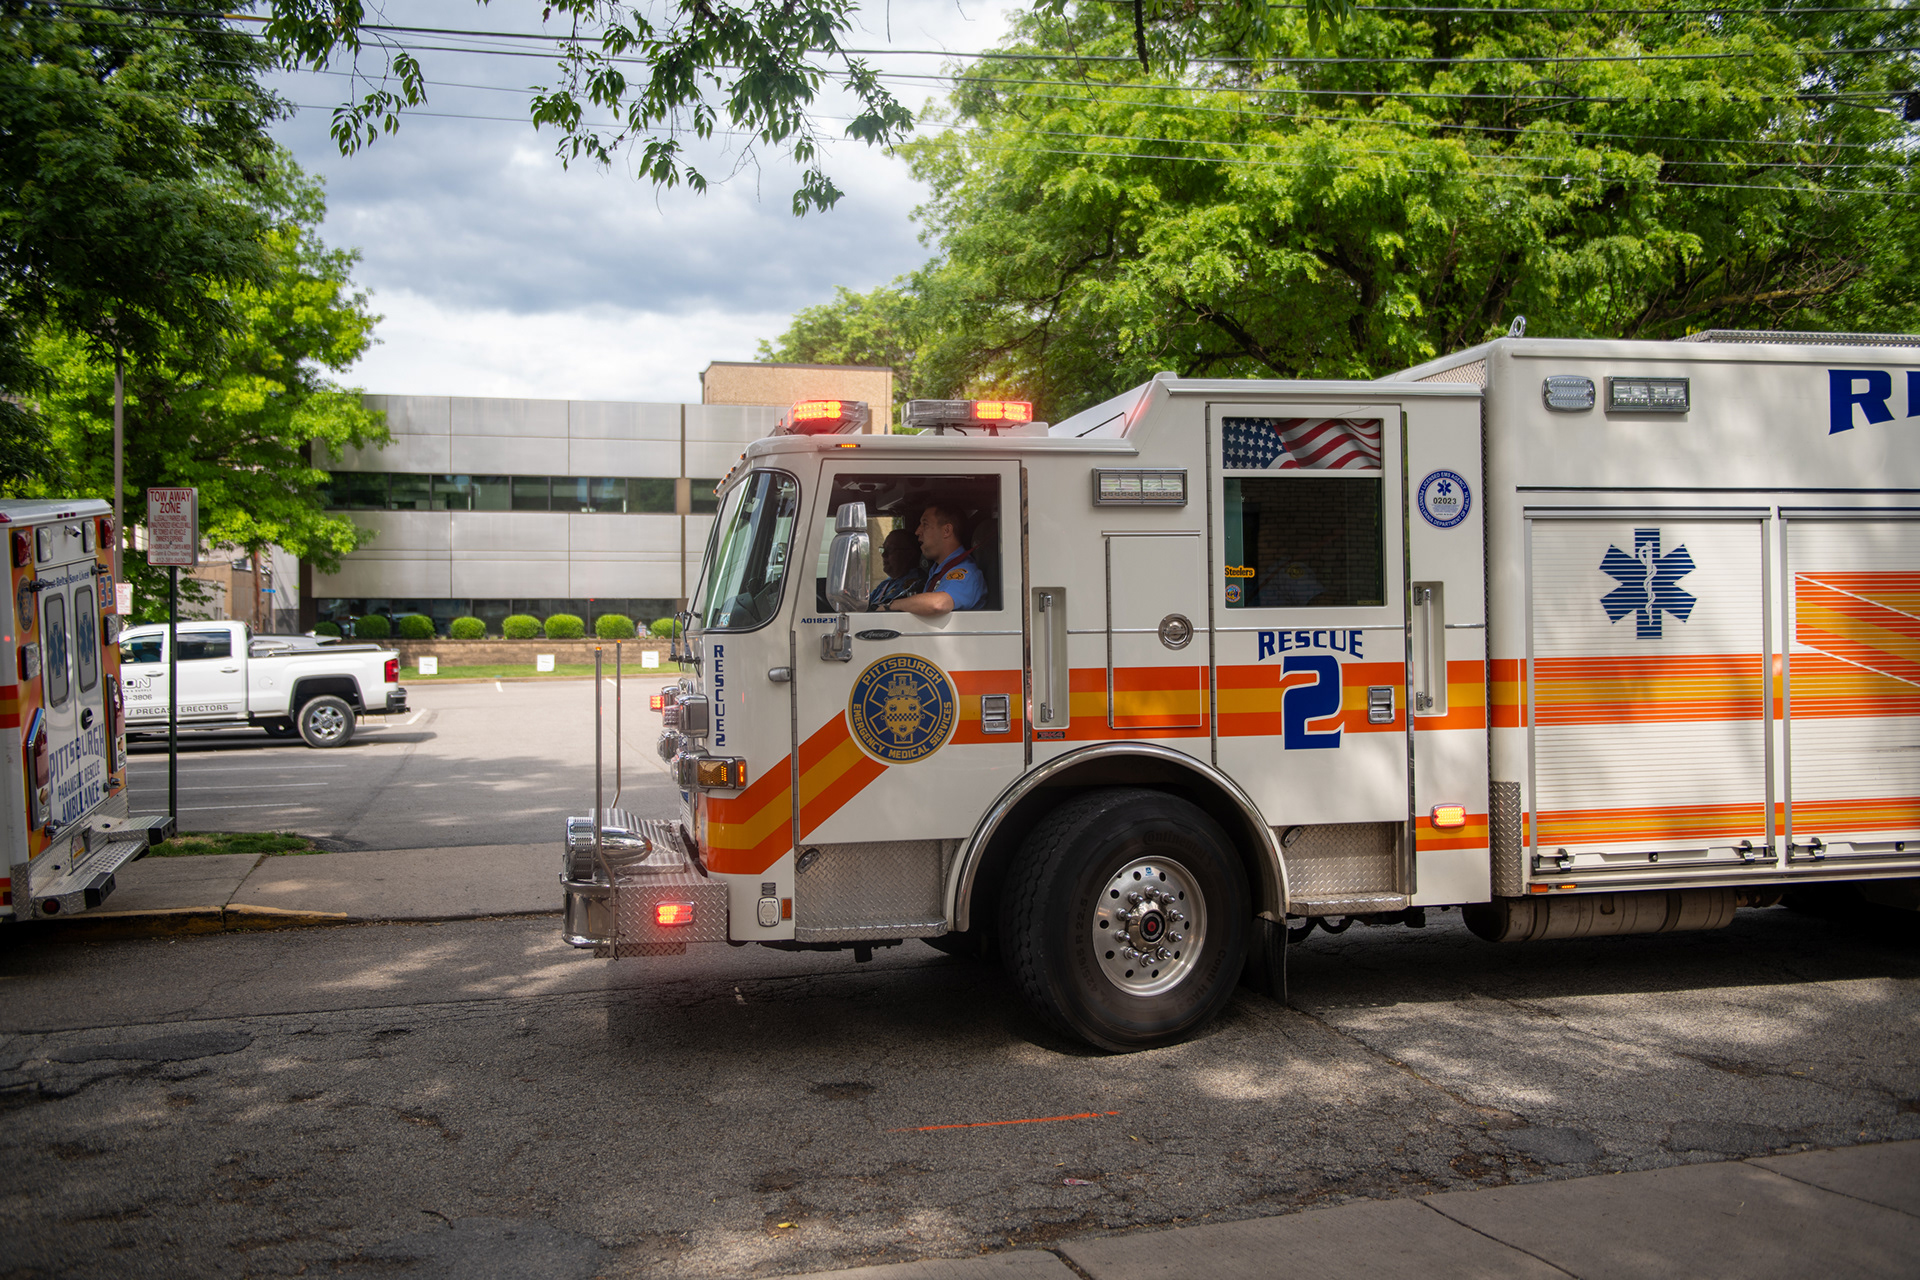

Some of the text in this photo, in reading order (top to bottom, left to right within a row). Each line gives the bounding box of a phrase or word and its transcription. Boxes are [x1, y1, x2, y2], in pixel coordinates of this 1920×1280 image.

[1828, 368, 1920, 436] R
[150, 490, 191, 502] TOW AWAY
[160, 502, 181, 514] ZONE
[1433, 497, 1457, 505] 02023
[1225, 566, 1254, 577] Steelers
[100, 574, 114, 609] 33
[1258, 630, 1363, 662] RESCUE
[861, 658, 943, 686] PITTSBURGH
[181, 704, 229, 713] ERECTORS
[1283, 655, 1342, 750] 2
[853, 701, 952, 759] EMERGENCY MEDICAL SERVICES
[49, 723, 106, 796] PITTSBURGH
[57, 759, 101, 802] PARAMEDIC RESCUE
[62, 779, 100, 823] AMBULANCE
[1142, 830, 1208, 860] Continental
[1075, 897, 1088, 931] 22.5
